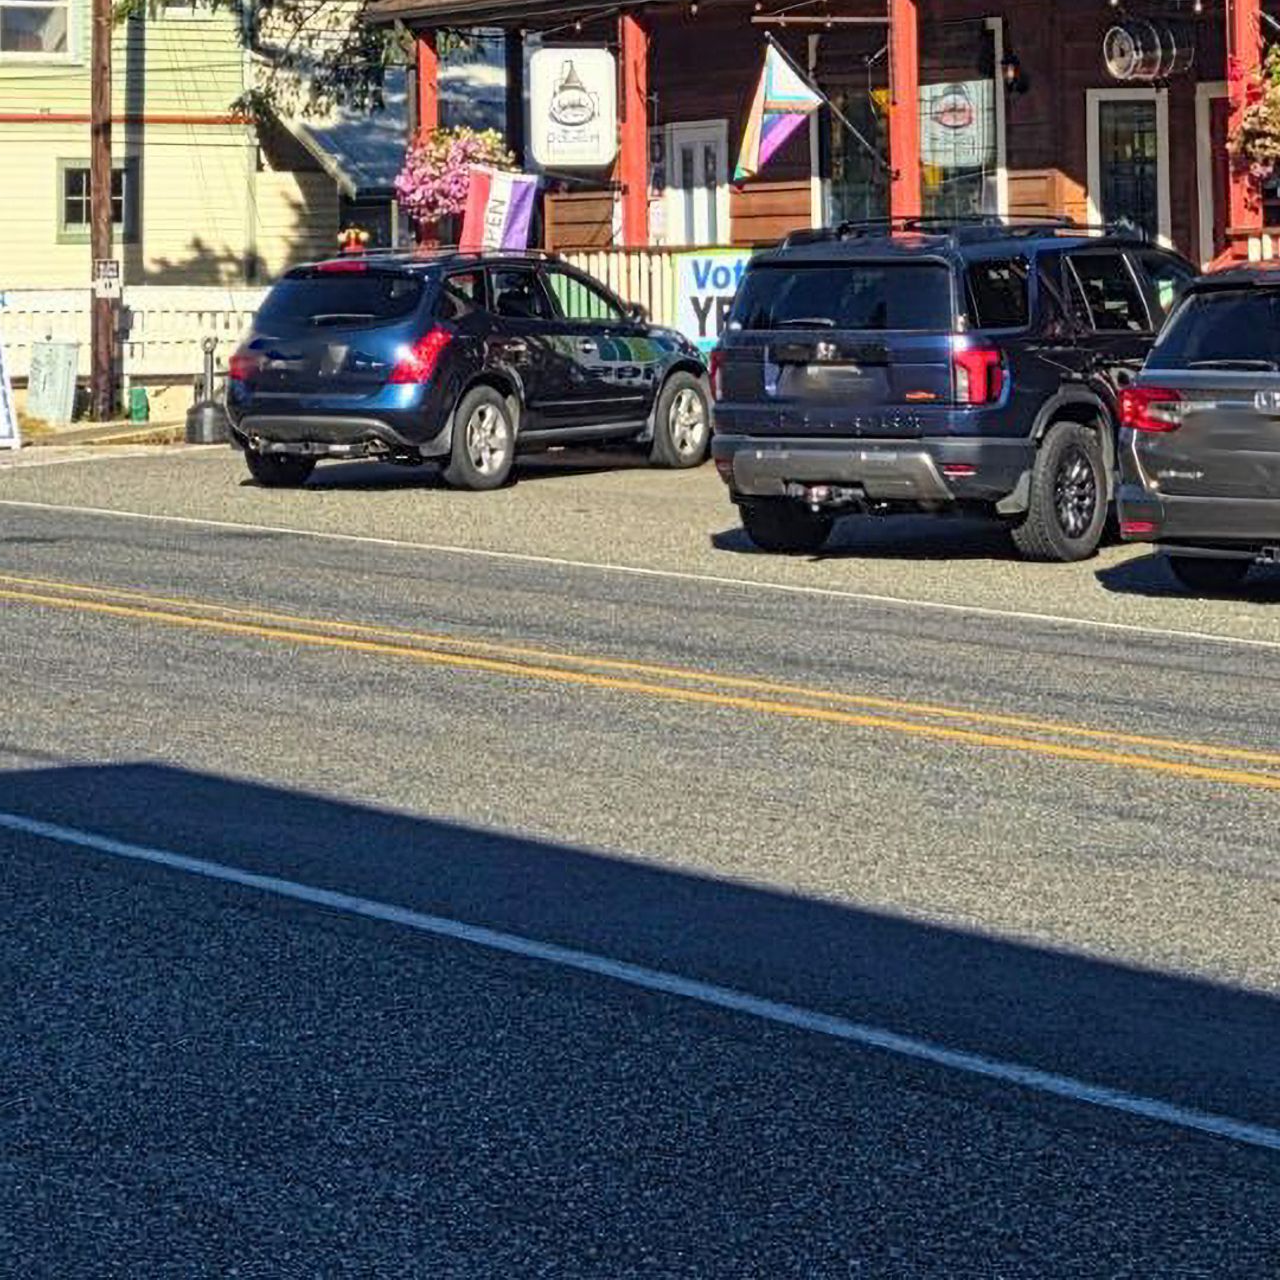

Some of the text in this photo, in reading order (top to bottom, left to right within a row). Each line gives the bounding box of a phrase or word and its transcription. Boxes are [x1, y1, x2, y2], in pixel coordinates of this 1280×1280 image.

[483, 198, 507, 251] PEN
[691, 259, 743, 290] Vot
[689, 296, 734, 337] YE
